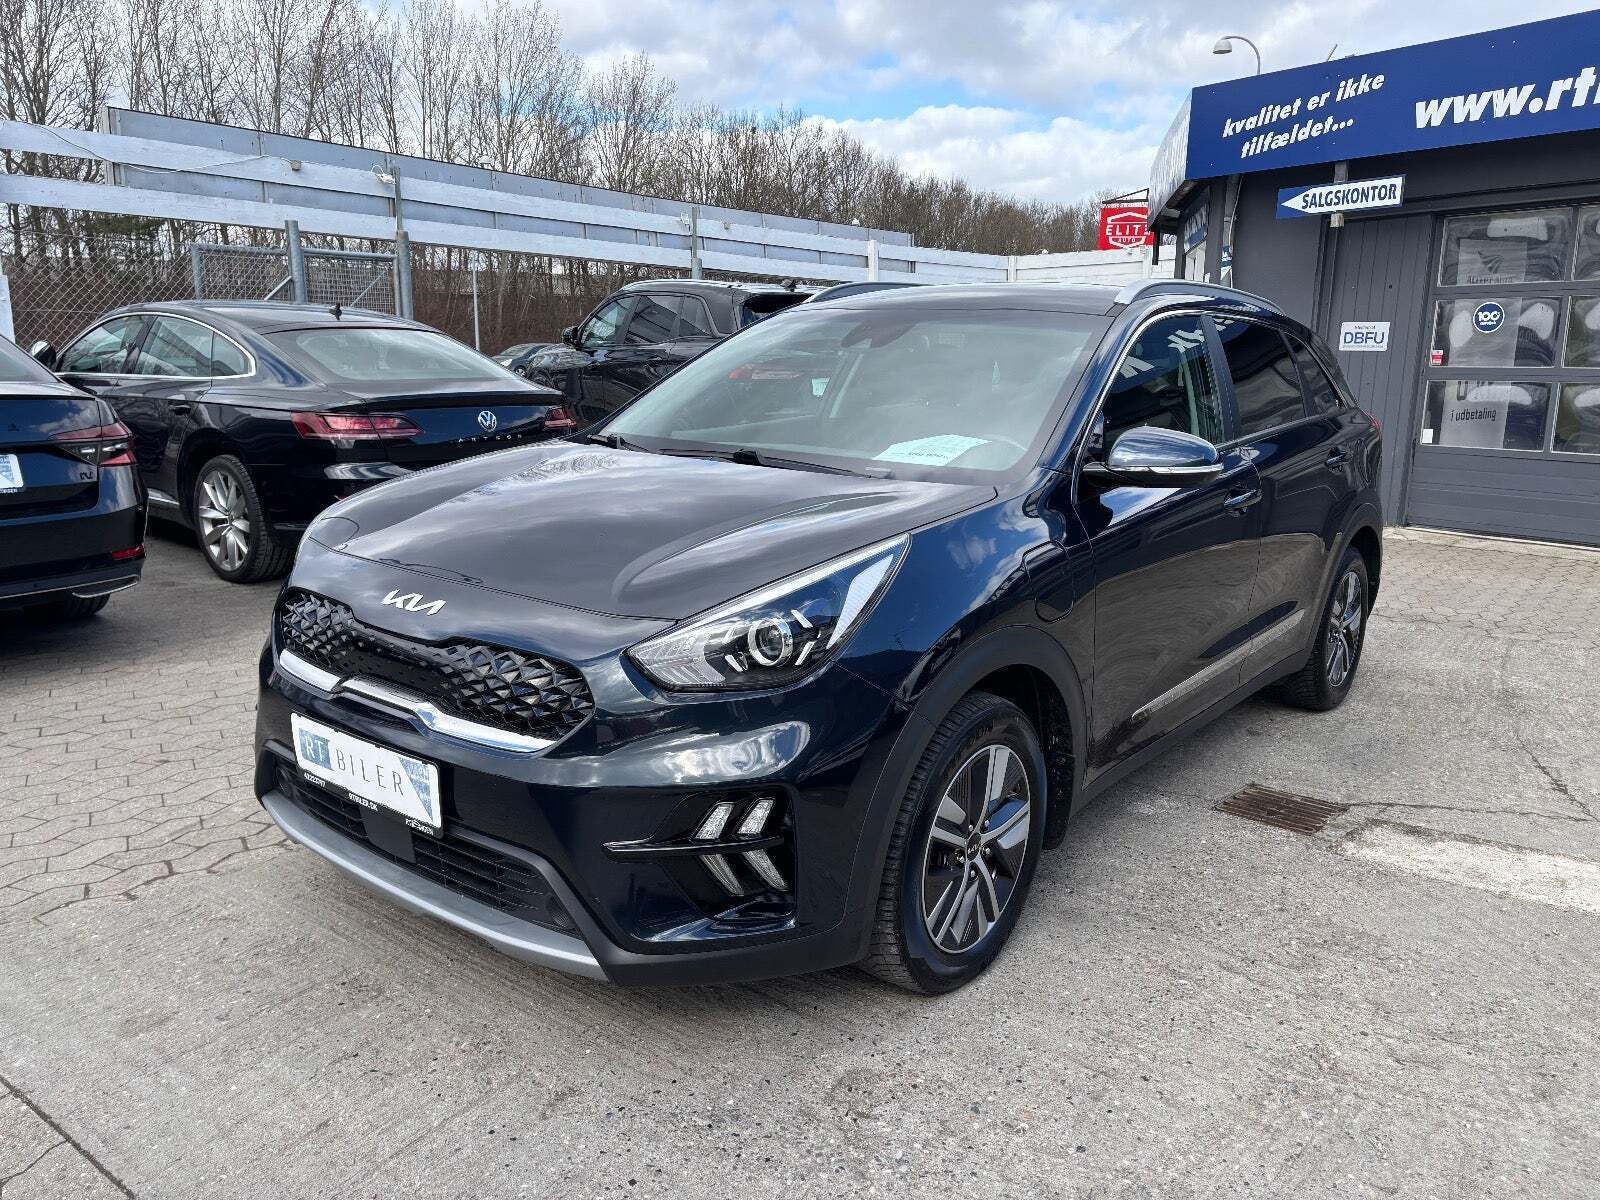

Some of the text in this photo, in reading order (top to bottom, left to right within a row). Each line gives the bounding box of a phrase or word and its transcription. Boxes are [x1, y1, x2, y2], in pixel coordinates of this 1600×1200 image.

[1222, 73, 1385, 138] kvalitet er ikke
[1415, 66, 1600, 129] www.rt
[1240, 115, 1354, 159] tilfældet...
[1301, 183, 1397, 210] SALGSKONTOR
[1343, 331, 1385, 344] DBFU
[1455, 407, 1497, 422] udbetaling
[305, 735, 328, 763] RT
[335, 748, 404, 796] BILER
